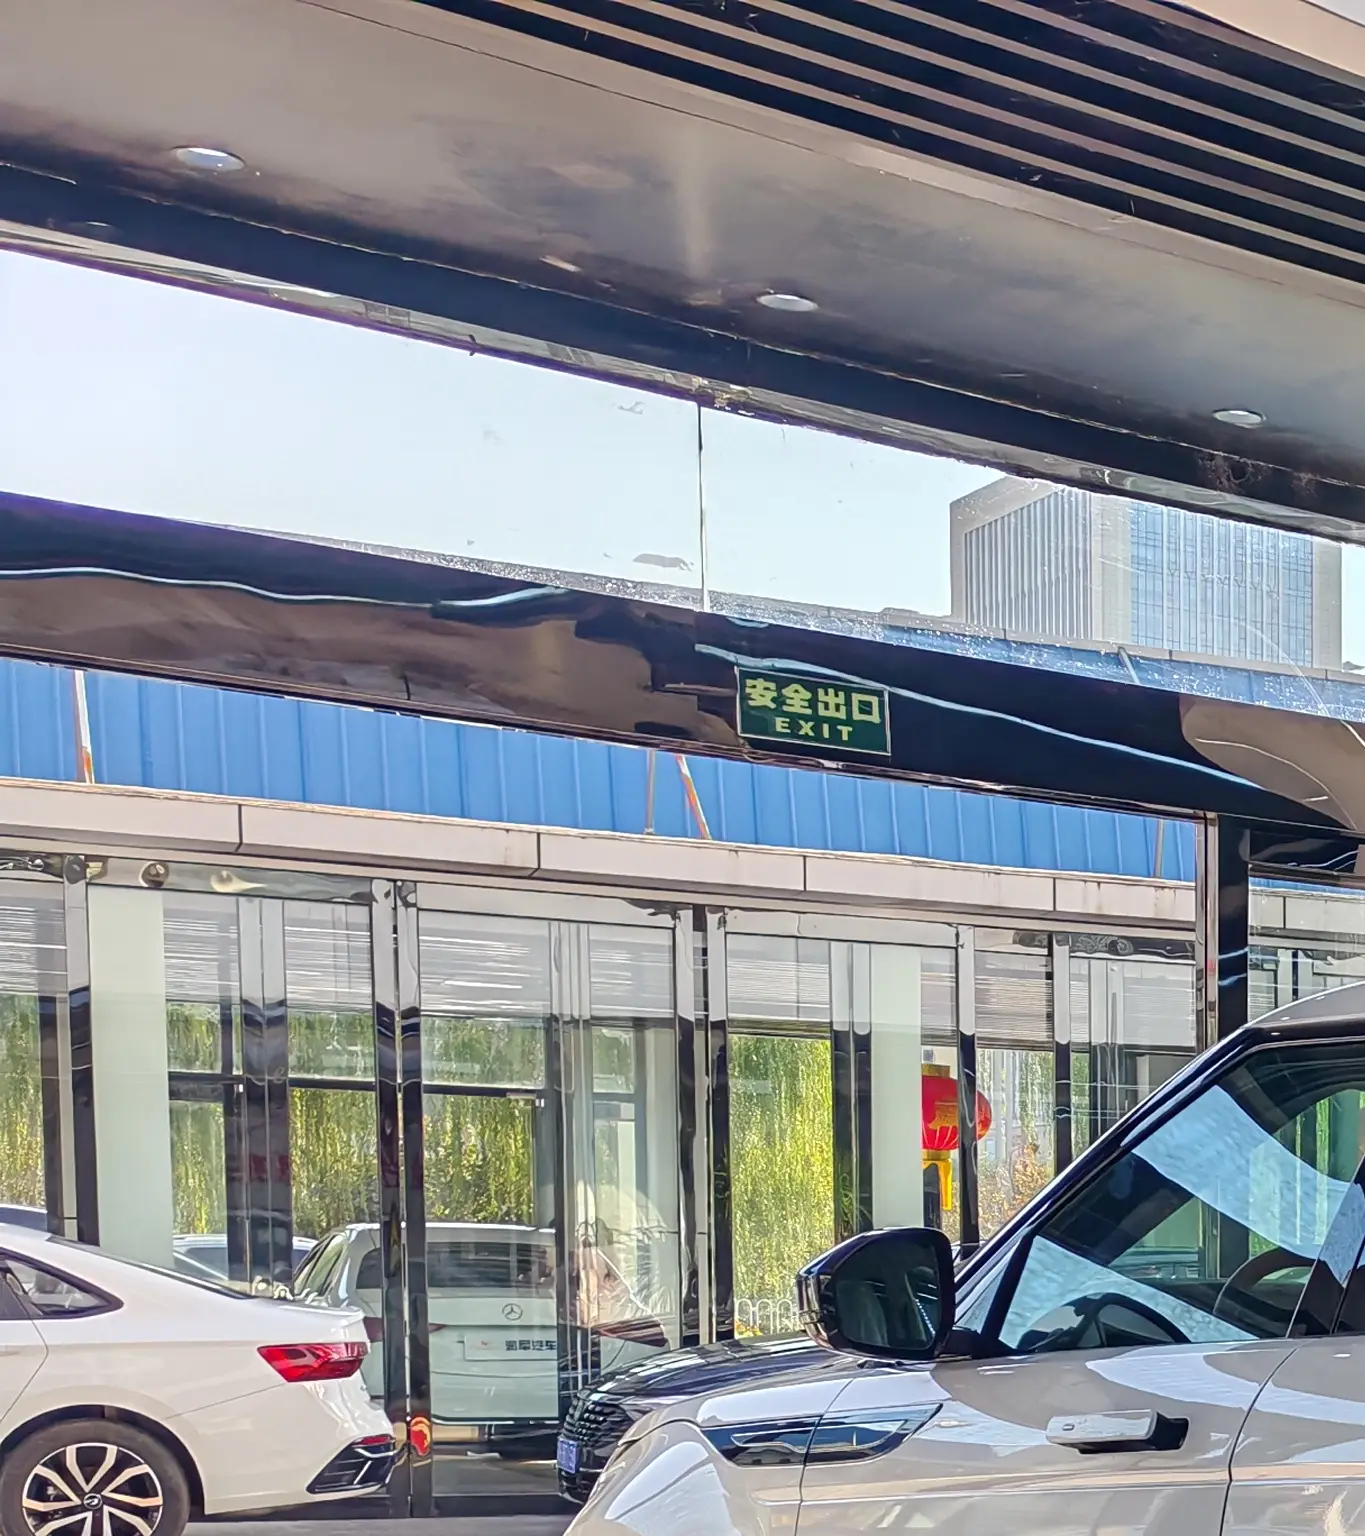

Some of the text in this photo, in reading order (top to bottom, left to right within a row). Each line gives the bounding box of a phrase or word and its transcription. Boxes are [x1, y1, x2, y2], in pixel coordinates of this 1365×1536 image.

[744, 677, 882, 725] 安全出口
[774, 716, 854, 741] EXIT
